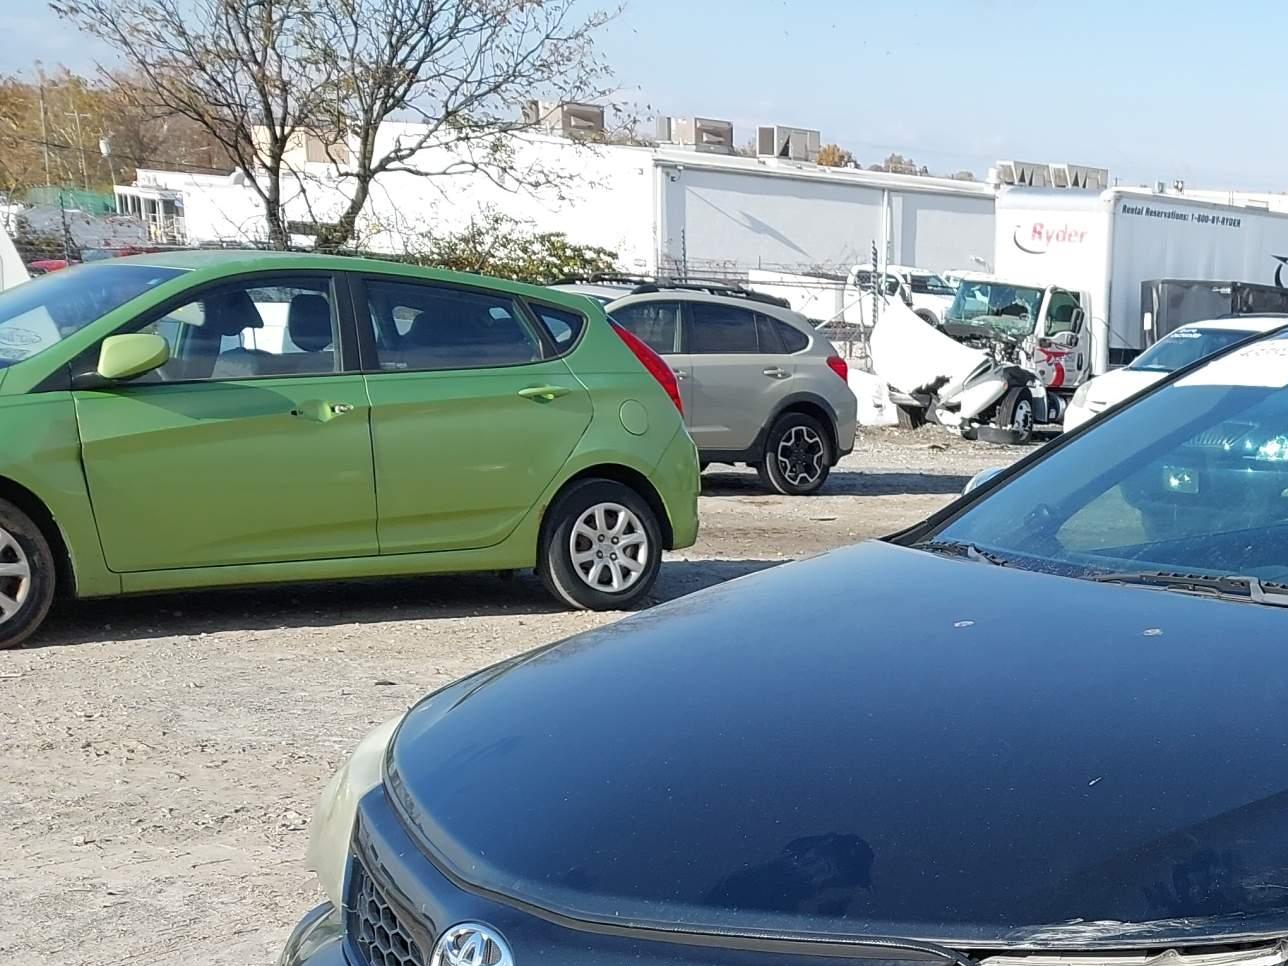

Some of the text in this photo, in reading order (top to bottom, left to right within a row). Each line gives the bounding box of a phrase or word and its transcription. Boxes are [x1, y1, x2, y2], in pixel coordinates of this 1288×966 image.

[1122, 204, 1241, 228] Rental Reservations: 1-800-BY-RYDER
[1031, 222, 1088, 246] Ryder
